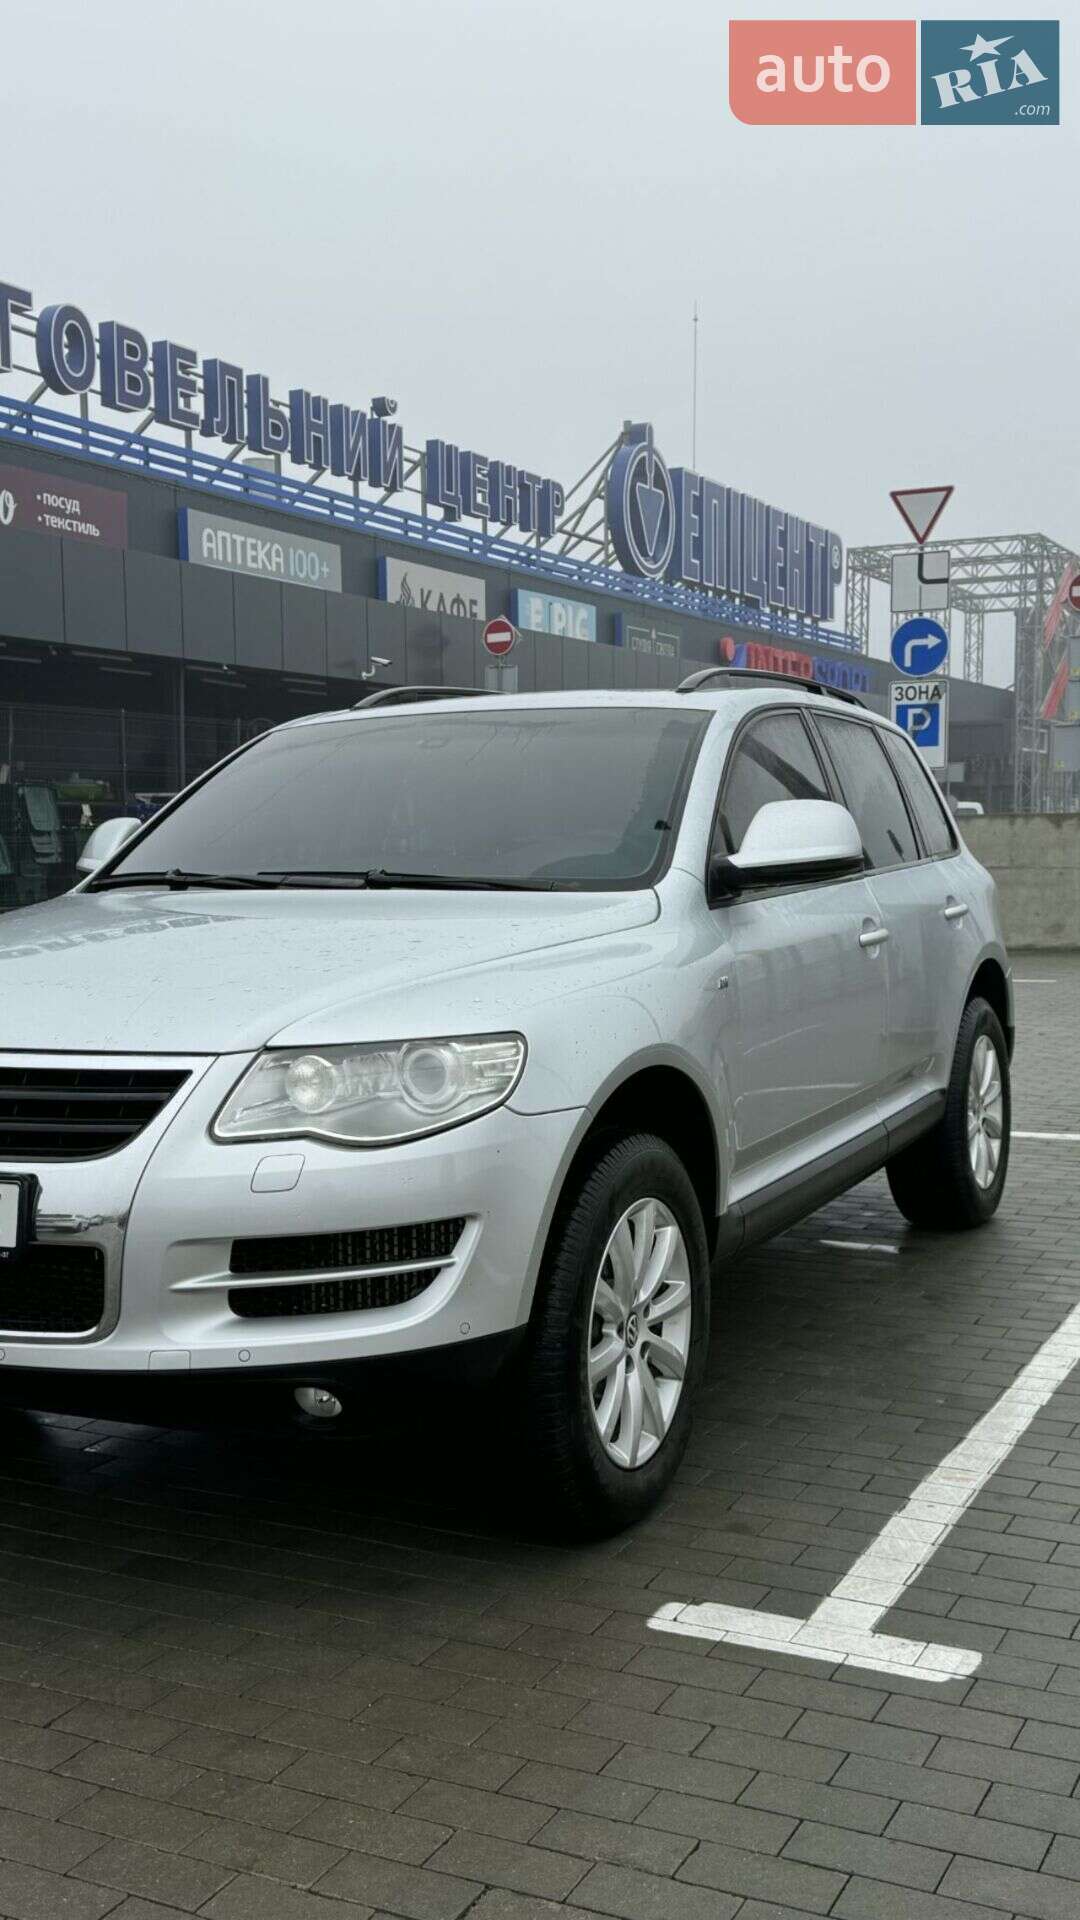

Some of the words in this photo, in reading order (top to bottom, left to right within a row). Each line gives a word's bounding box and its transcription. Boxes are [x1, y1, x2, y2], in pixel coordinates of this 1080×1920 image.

[426, 439, 565, 538] ЦЕНТР
[202, 527, 285, 574] АПТЕКА
[894, 685, 942, 701] ЗОНА
